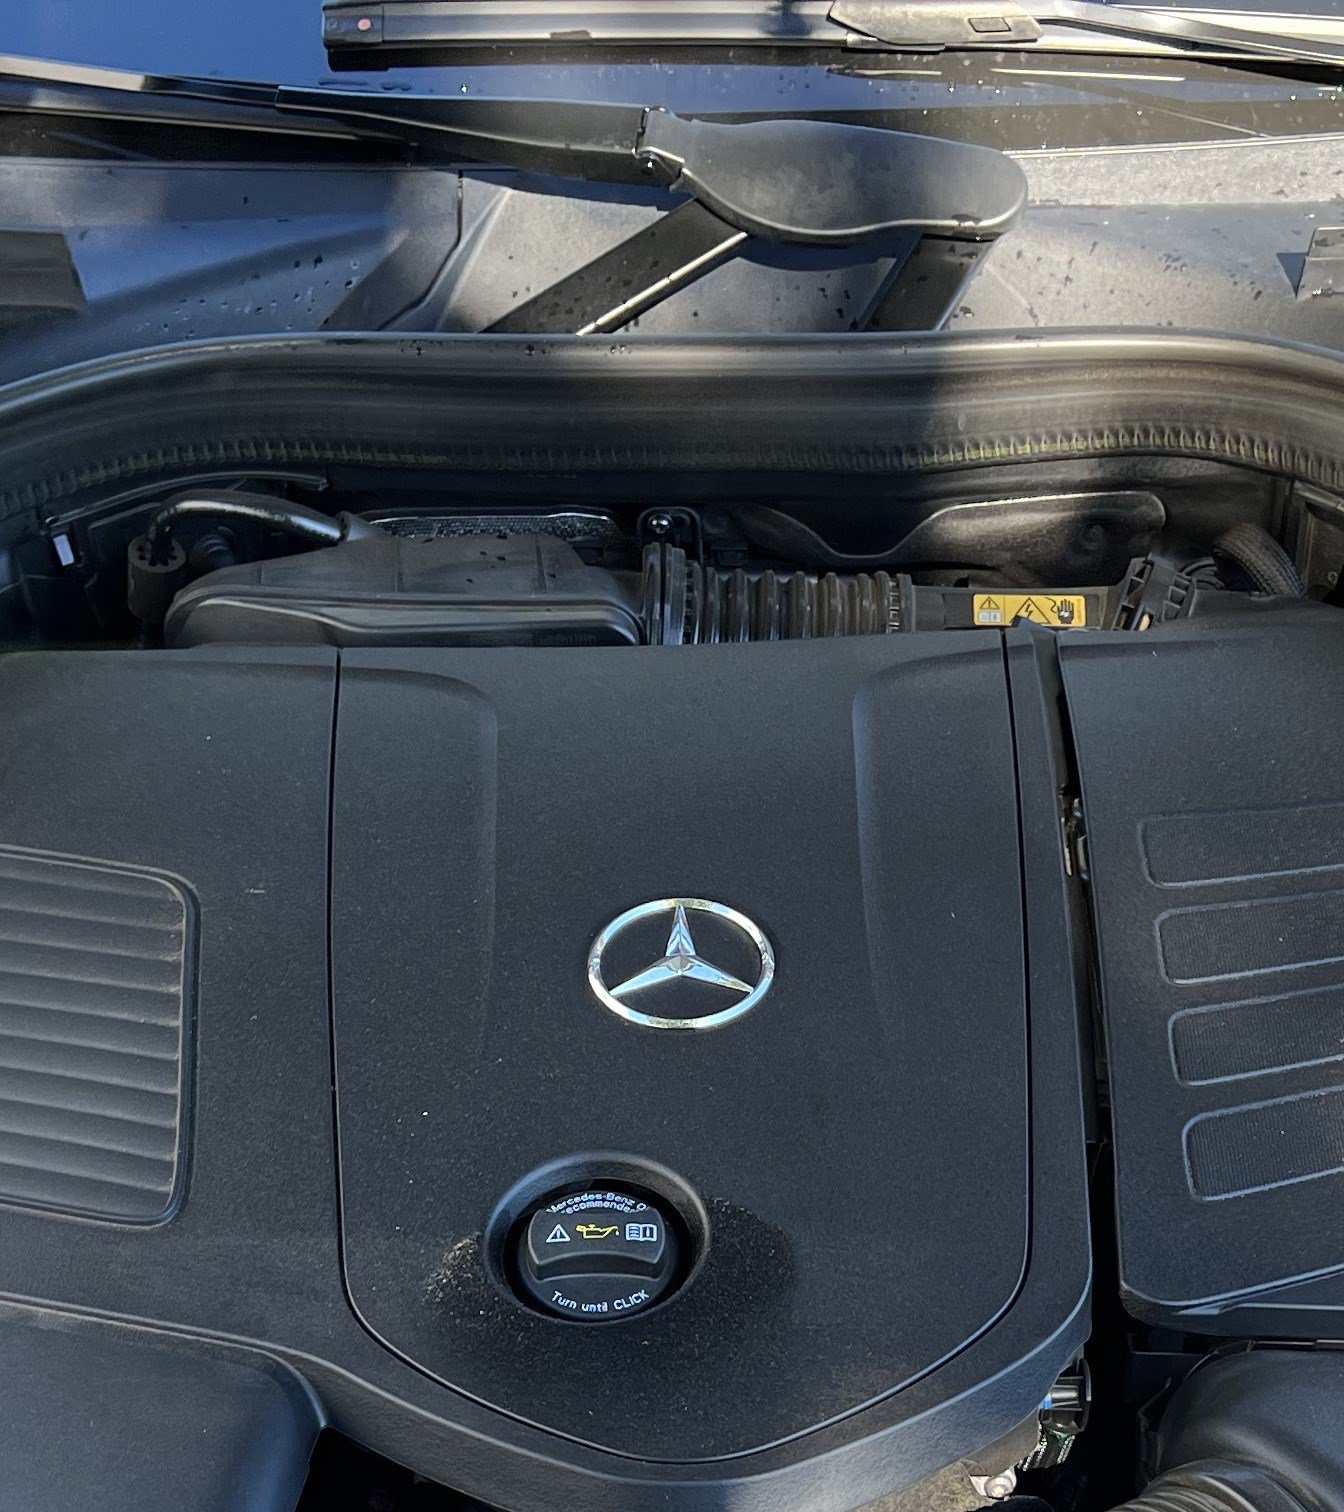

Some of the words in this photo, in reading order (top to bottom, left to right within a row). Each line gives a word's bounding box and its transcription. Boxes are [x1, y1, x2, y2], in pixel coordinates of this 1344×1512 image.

[546, 1191, 636, 1213] Mercedes-Benz
[551, 1290, 577, 1309] Turn
[581, 1301, 608, 1312] until
[613, 1289, 649, 1310] CLICK
